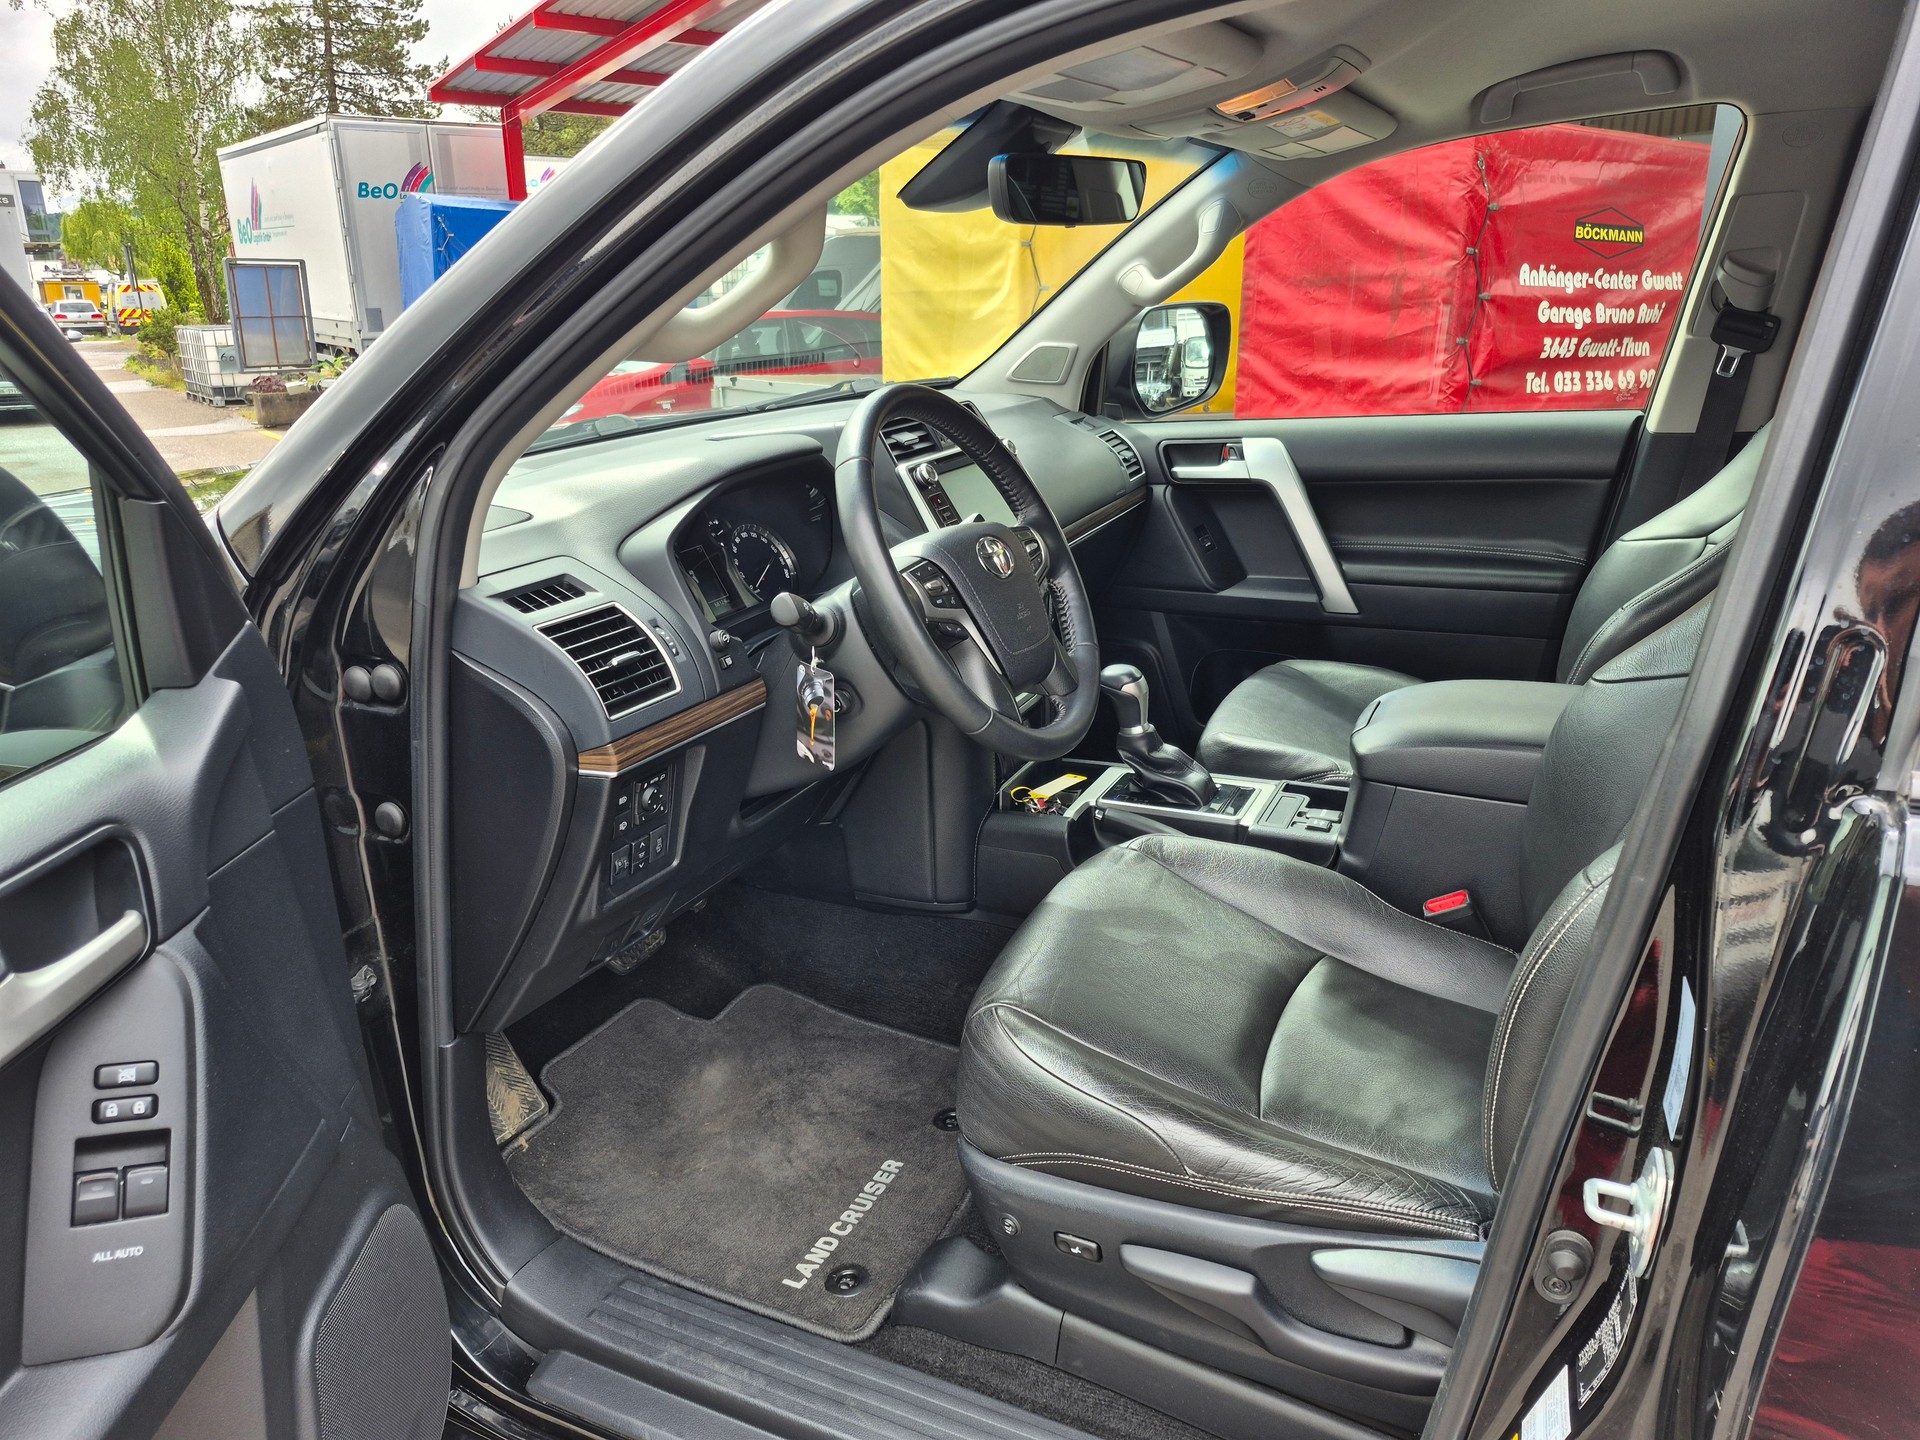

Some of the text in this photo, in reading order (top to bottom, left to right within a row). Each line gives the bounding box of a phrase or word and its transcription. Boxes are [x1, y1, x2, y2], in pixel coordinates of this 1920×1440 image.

[357, 181, 399, 200] BeO
[237, 217, 252, 244] BeO
[1575, 224, 1643, 243] BÖCKMANN
[1519, 263, 1683, 294] Anhänger-Center Gwatt
[1537, 300, 1592, 330] Garage
[1595, 302, 1635, 324] Bruno
[1540, 337, 1651, 359] 3645 Gwatt-Thun
[1525, 371, 1550, 394] Tel.
[1553, 370, 1581, 393] 033
[1585, 369, 1614, 392] 336
[1617, 369, 1636, 390] 69
[781, 1159, 905, 1289] LAND CRUISER
[92, 1246, 144, 1263] ALL AUTO
